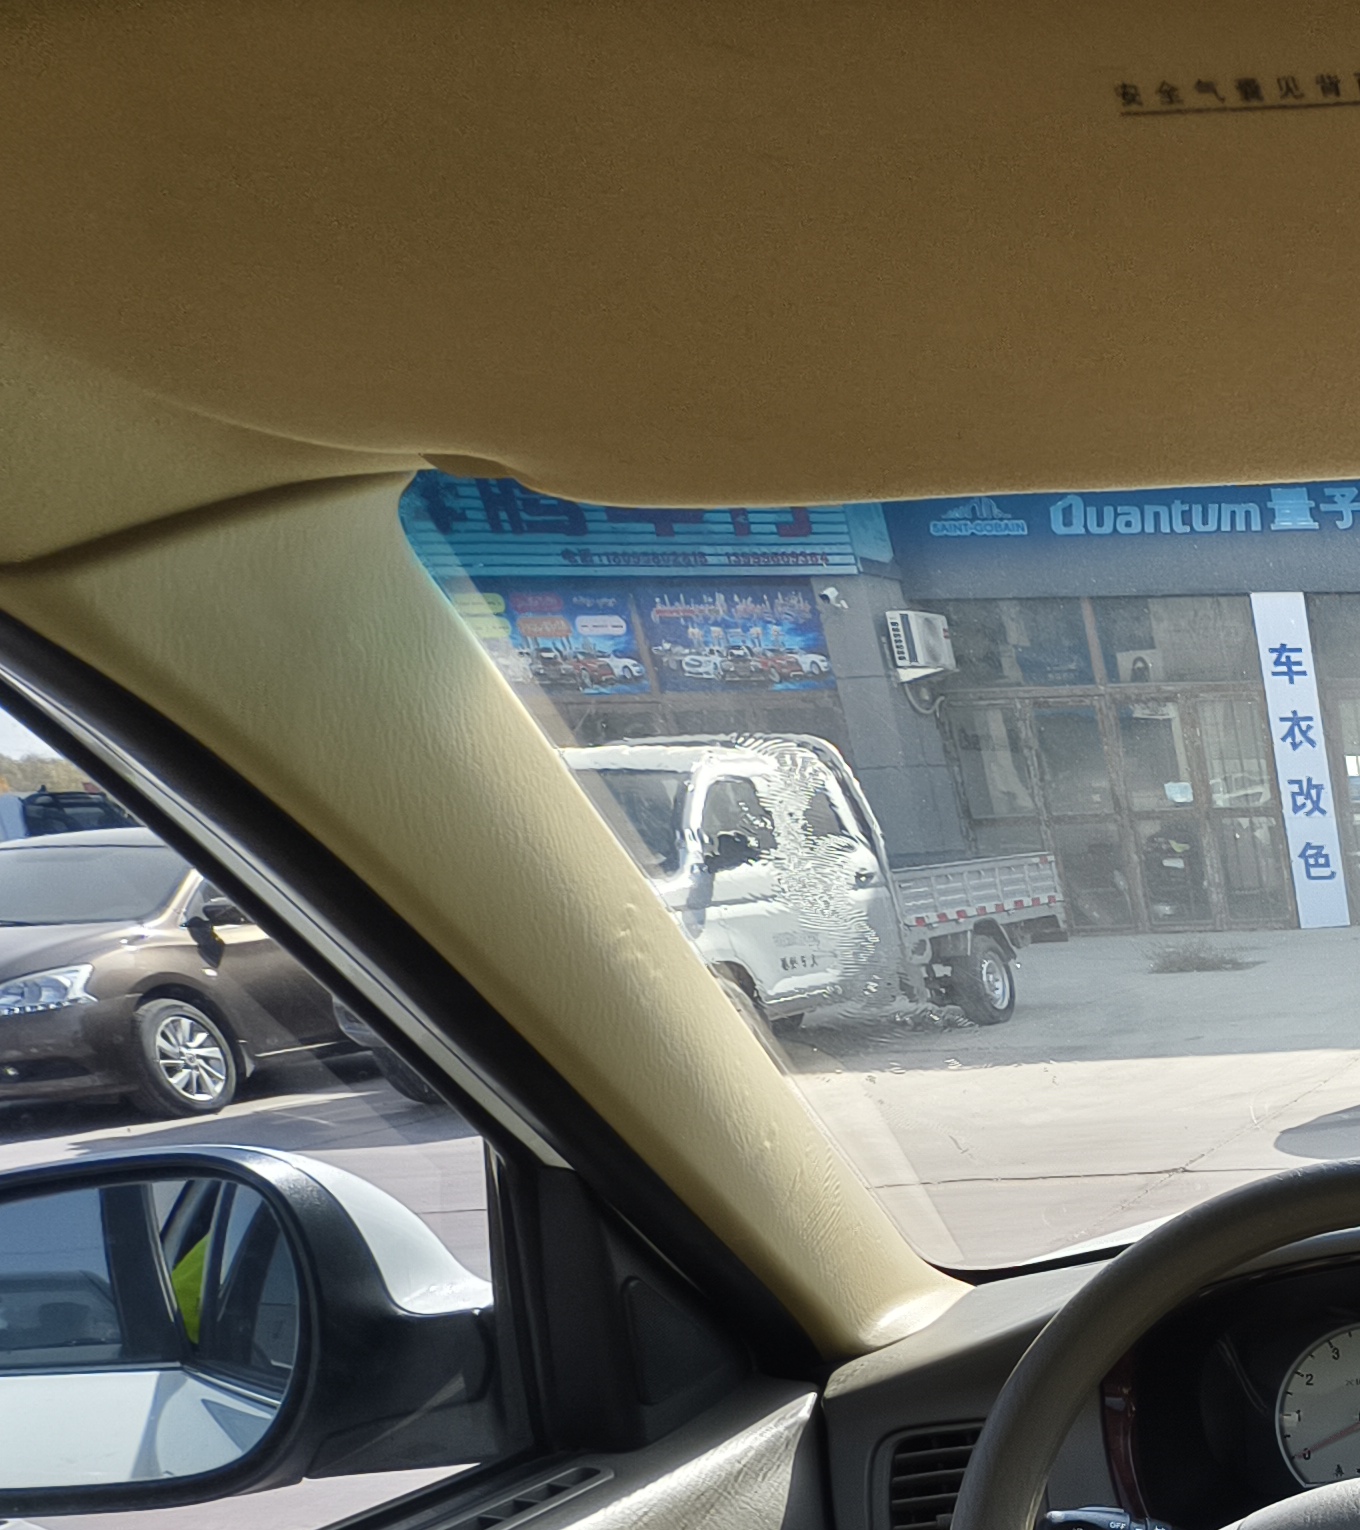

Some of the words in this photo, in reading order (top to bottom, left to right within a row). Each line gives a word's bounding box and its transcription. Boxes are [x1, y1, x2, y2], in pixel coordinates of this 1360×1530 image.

[1050, 493, 1262, 535] Quantum
[1268, 643, 1337, 881] 车衣改色
[1332, 1347, 1340, 1359] 3
[1305, 1374, 1314, 1386] 2
[1109, 1521, 1126, 1530] OFF
